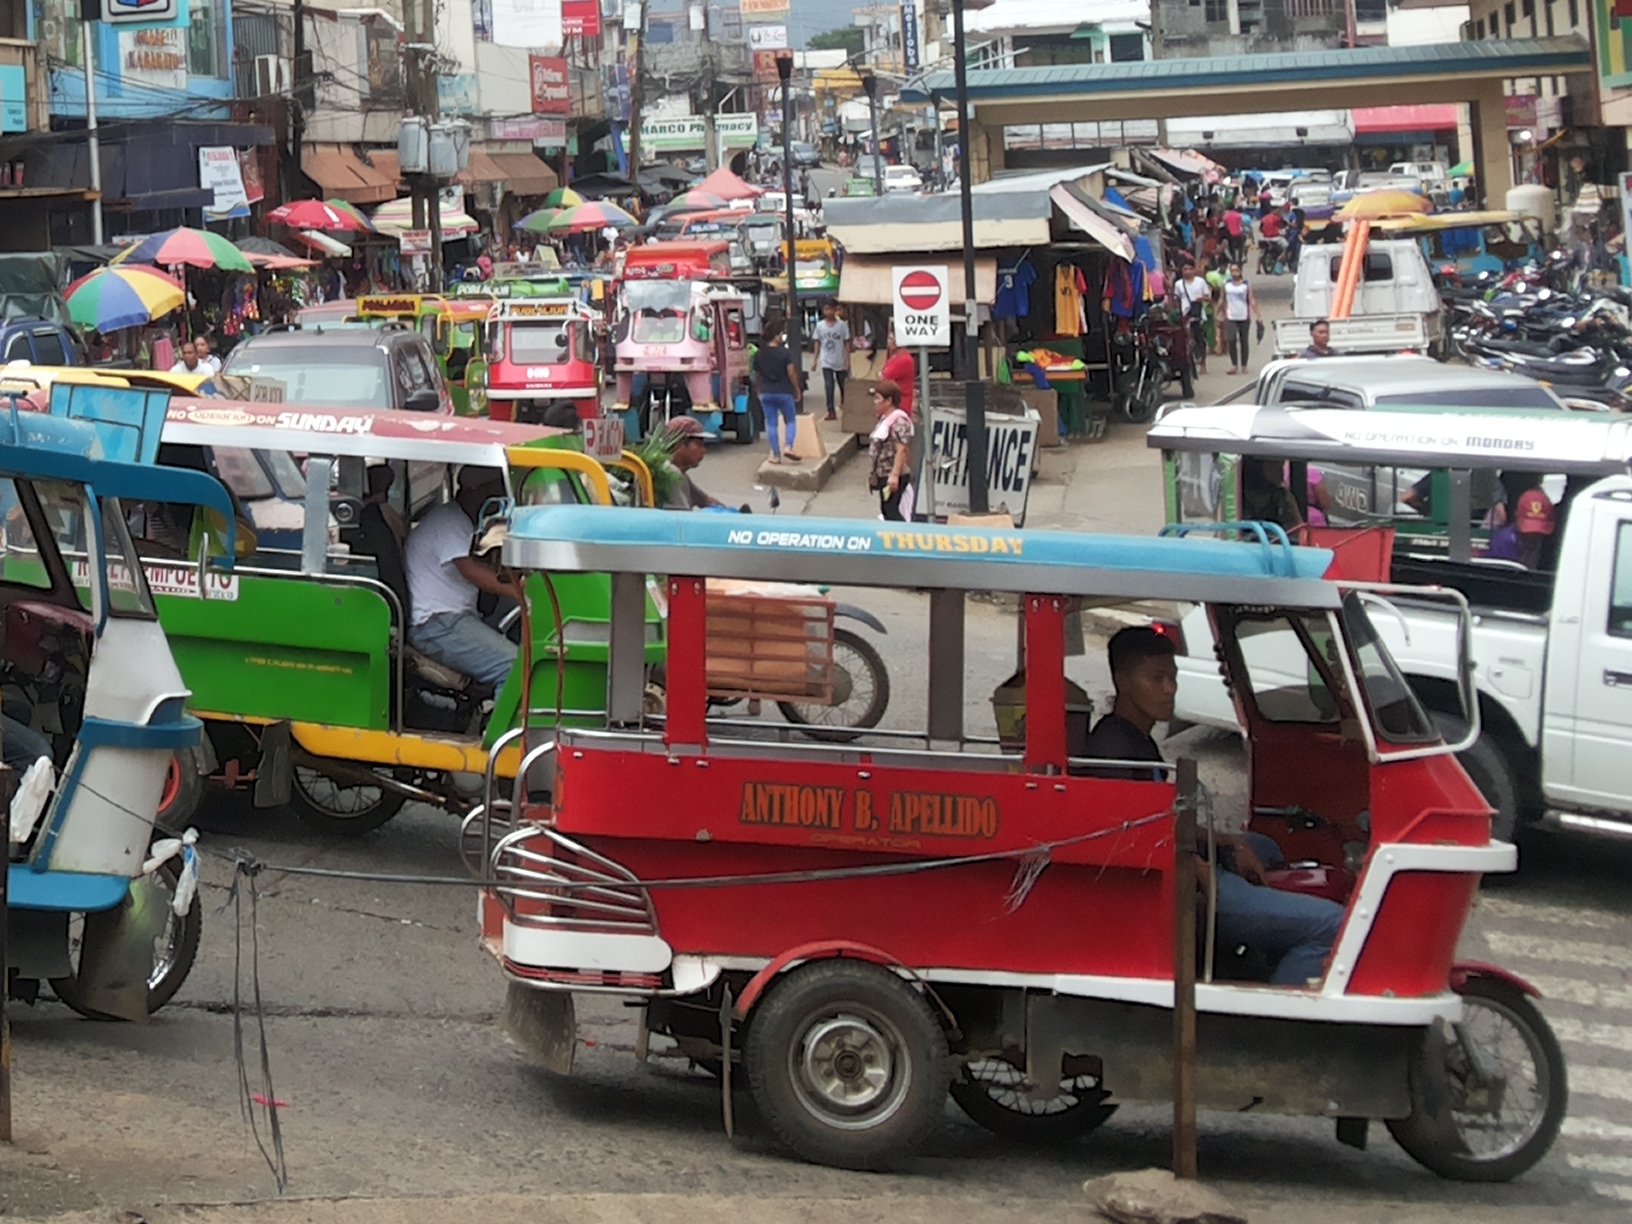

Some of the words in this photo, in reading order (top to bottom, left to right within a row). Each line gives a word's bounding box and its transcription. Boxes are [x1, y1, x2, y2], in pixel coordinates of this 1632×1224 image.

[905, 314, 939, 326] ONE
[904, 325, 939, 337] WAY
[167, 408, 187, 420] NO
[257, 415, 276, 426] ON
[276, 411, 374, 436] SUNDAY
[1366, 432, 1437, 445] OPERATION
[1441, 437, 1458, 446] ON
[1466, 436, 1535, 451] MONDAY
[728, 530, 753, 545] NO
[756, 530, 846, 550] OPERATION
[847, 535, 871, 551] ON
[876, 531, 1025, 555] THURSDAY
[740, 781, 845, 829] ANTHONY
[854, 788, 879, 831] B.
[889, 791, 1000, 839] APELLIDO
[810, 832, 922, 851] OPERATOR
